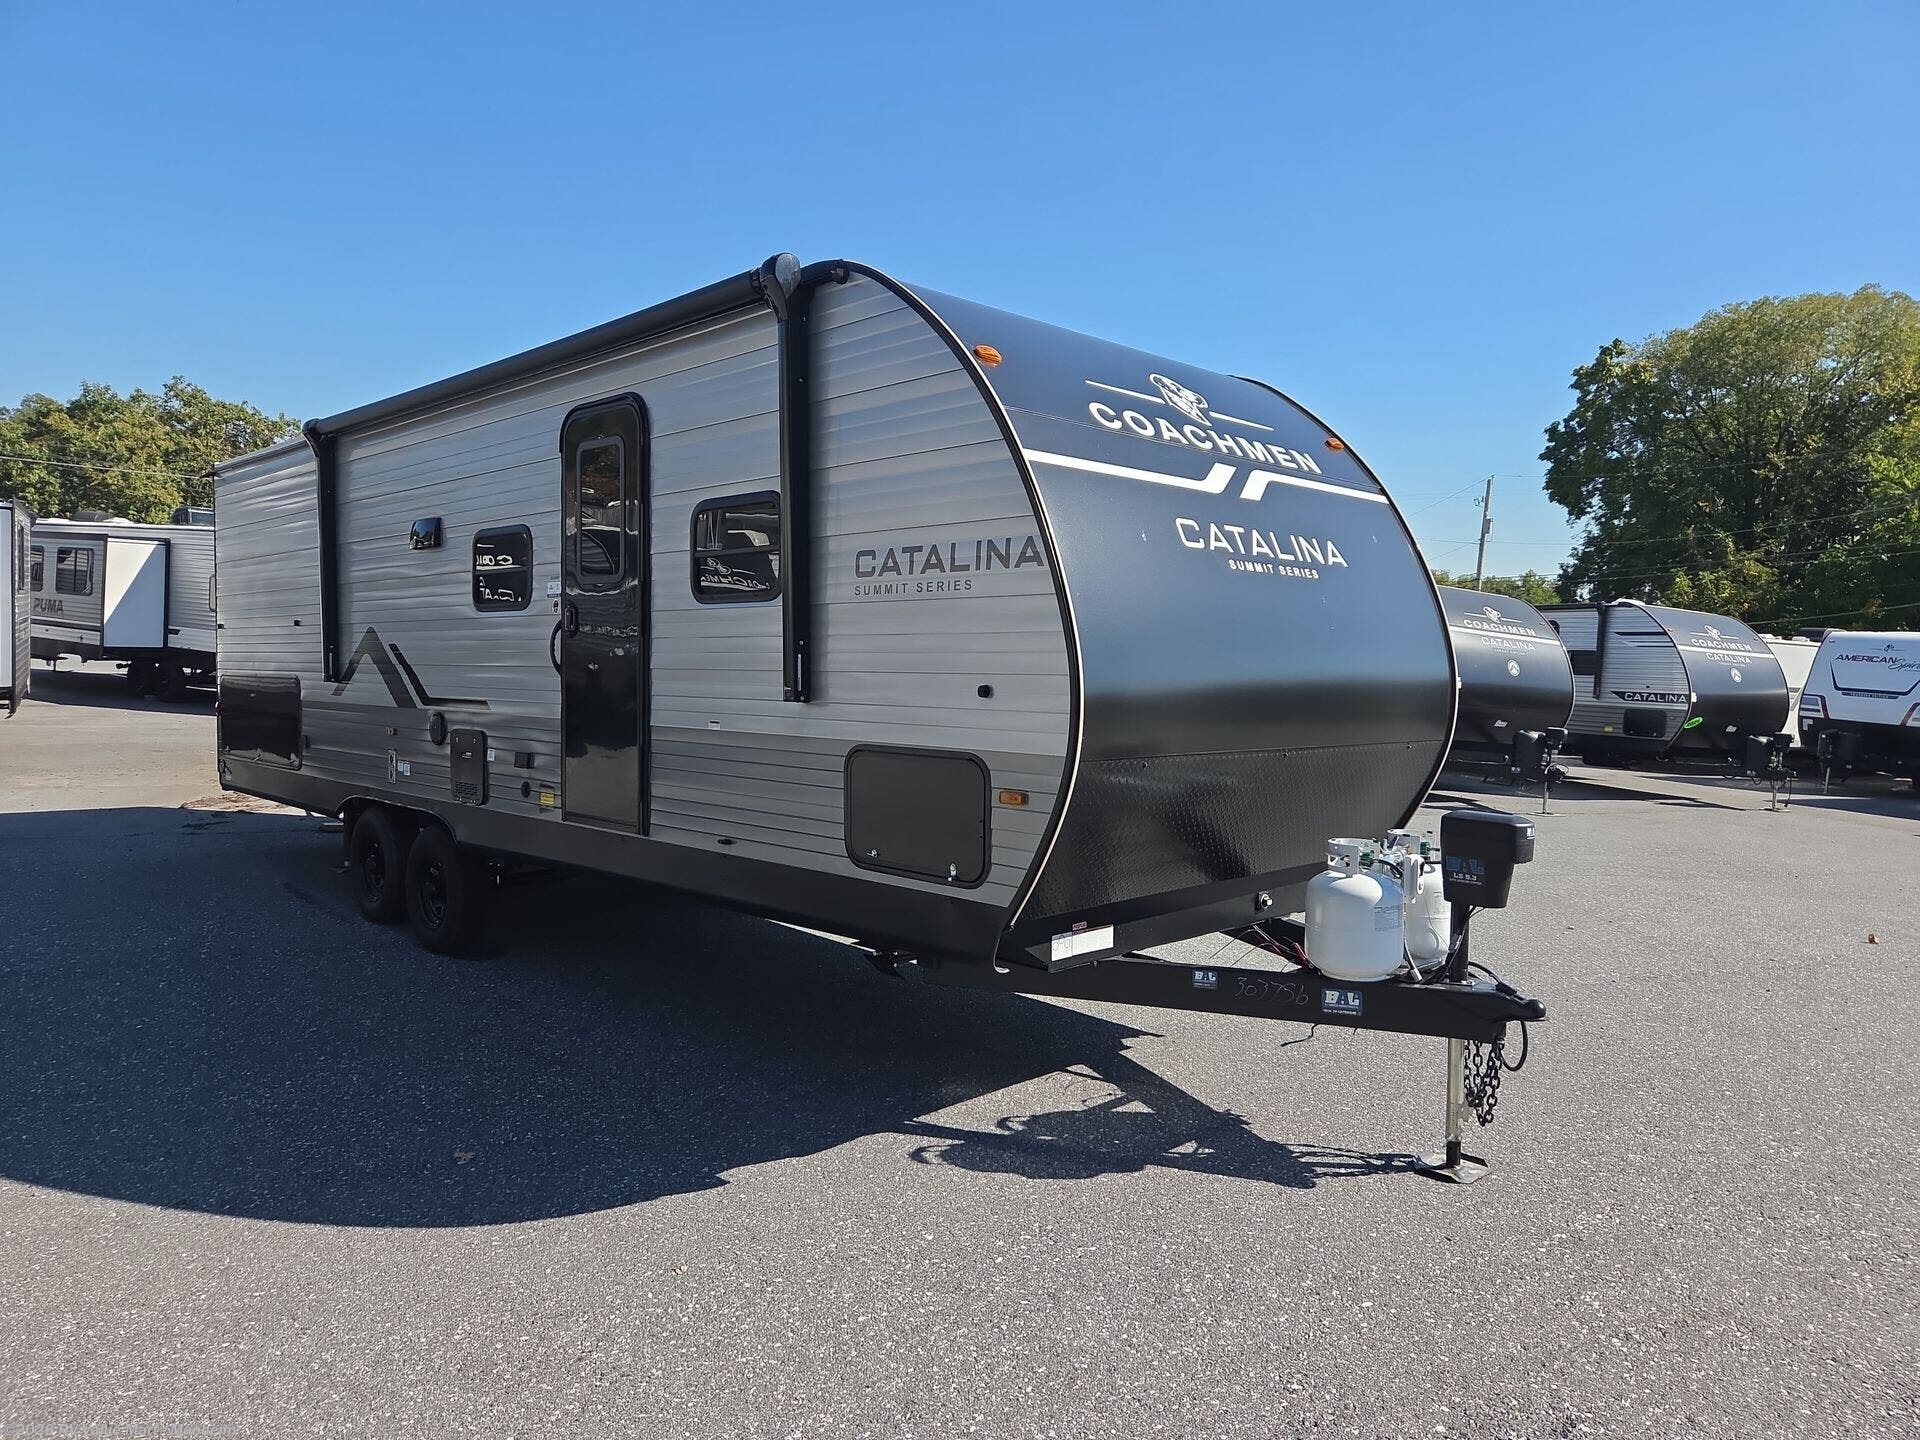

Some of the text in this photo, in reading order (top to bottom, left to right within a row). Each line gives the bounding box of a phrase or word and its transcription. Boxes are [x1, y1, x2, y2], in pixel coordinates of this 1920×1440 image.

[1088, 401, 1322, 474] COACHMEN
[1175, 517, 1349, 568] CATALINA
[854, 535, 1045, 579] CATALINA
[1228, 558, 1319, 580] SUMMIT SERIES
[854, 579, 972, 596] SUMMIT SERIES
[33, 597, 64, 614] PUMA
[1463, 619, 1536, 636] COACHMEN
[1481, 637, 1536, 651] CATALINA
[1691, 638, 1752, 651] COACHMEN
[1705, 652, 1753, 664] CATALINA
[1835, 653, 1898, 664] AMERICAN
[1624, 692, 1687, 703] CATALINA
